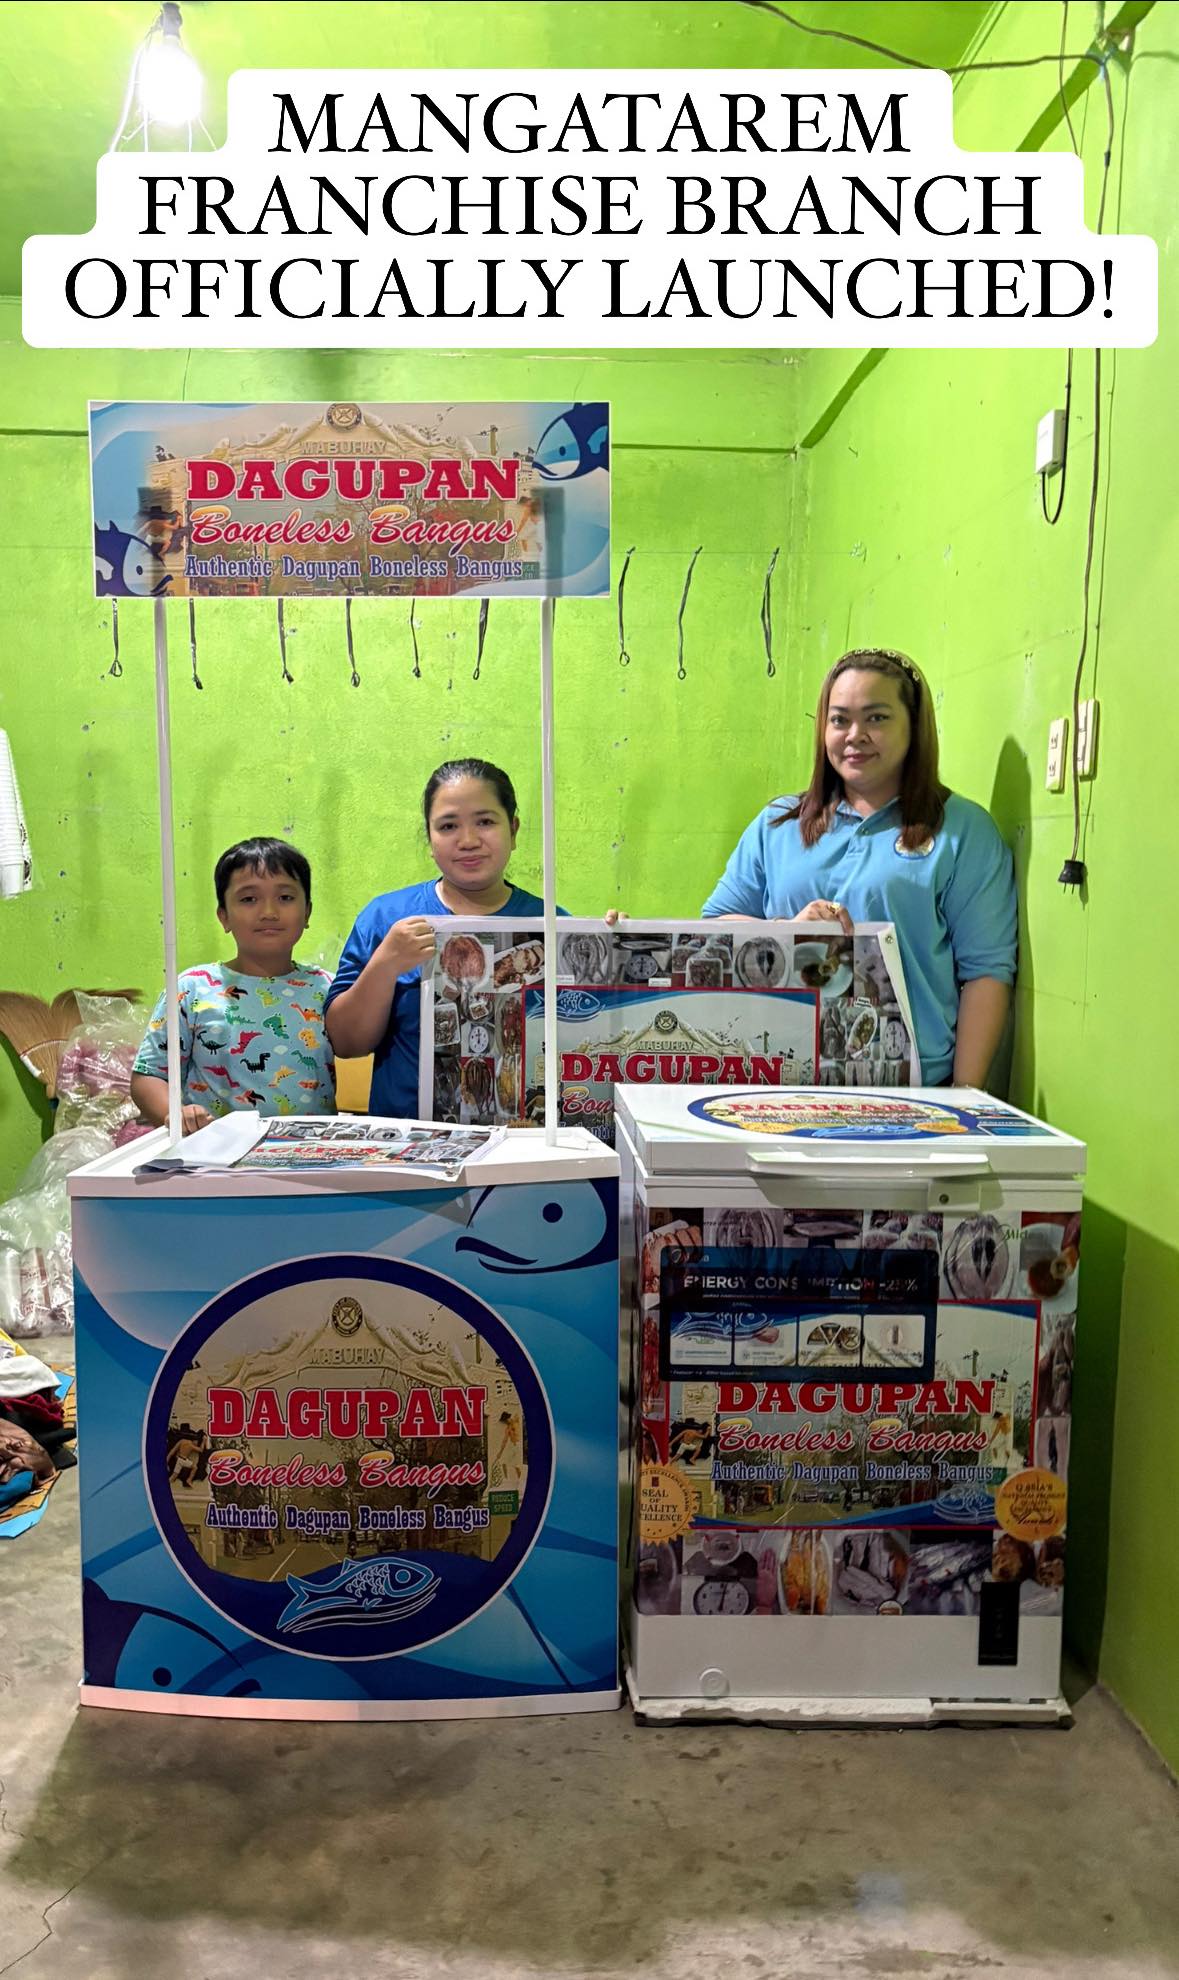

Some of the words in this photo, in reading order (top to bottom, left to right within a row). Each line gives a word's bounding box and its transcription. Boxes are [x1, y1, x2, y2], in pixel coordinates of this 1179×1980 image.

[302, 440, 387, 454] MABUHAY
[186, 459, 520, 500] DAGUPAN
[190, 505, 354, 545] Boneless
[369, 505, 517, 557] Bangus
[185, 555, 272, 577] Authentic
[282, 555, 360, 581] Dagupan
[370, 555, 447, 577] Boneless
[457, 555, 522, 581] Bangus
[636, 1040, 694, 1050] MABUHAY
[561, 1053, 784, 1085] DAGUPAN
[309, 1348, 386, 1365] MABUHAY
[207, 1386, 488, 1439] DAGUPAN
[715, 1380, 996, 1416] DAGUPAN
[717, 1417, 854, 1452] Boneless
[866, 1417, 989, 1463] Bangus
[208, 1449, 348, 1488] Boneless
[358, 1451, 486, 1499] Bangus
[711, 1460, 786, 1481] Authentic
[792, 1460, 859, 1484] Dagupan
[865, 1460, 931, 1481] Boneless
[938, 1460, 993, 1484] Bangus
[640, 1503, 678, 1513] UALITY
[642, 1488, 669, 1498] SEAL
[206, 1503, 278, 1529] Authentic
[285, 1504, 350, 1535] Dagupan
[358, 1504, 426, 1530] Boneless
[433, 1504, 490, 1533] Bangus
